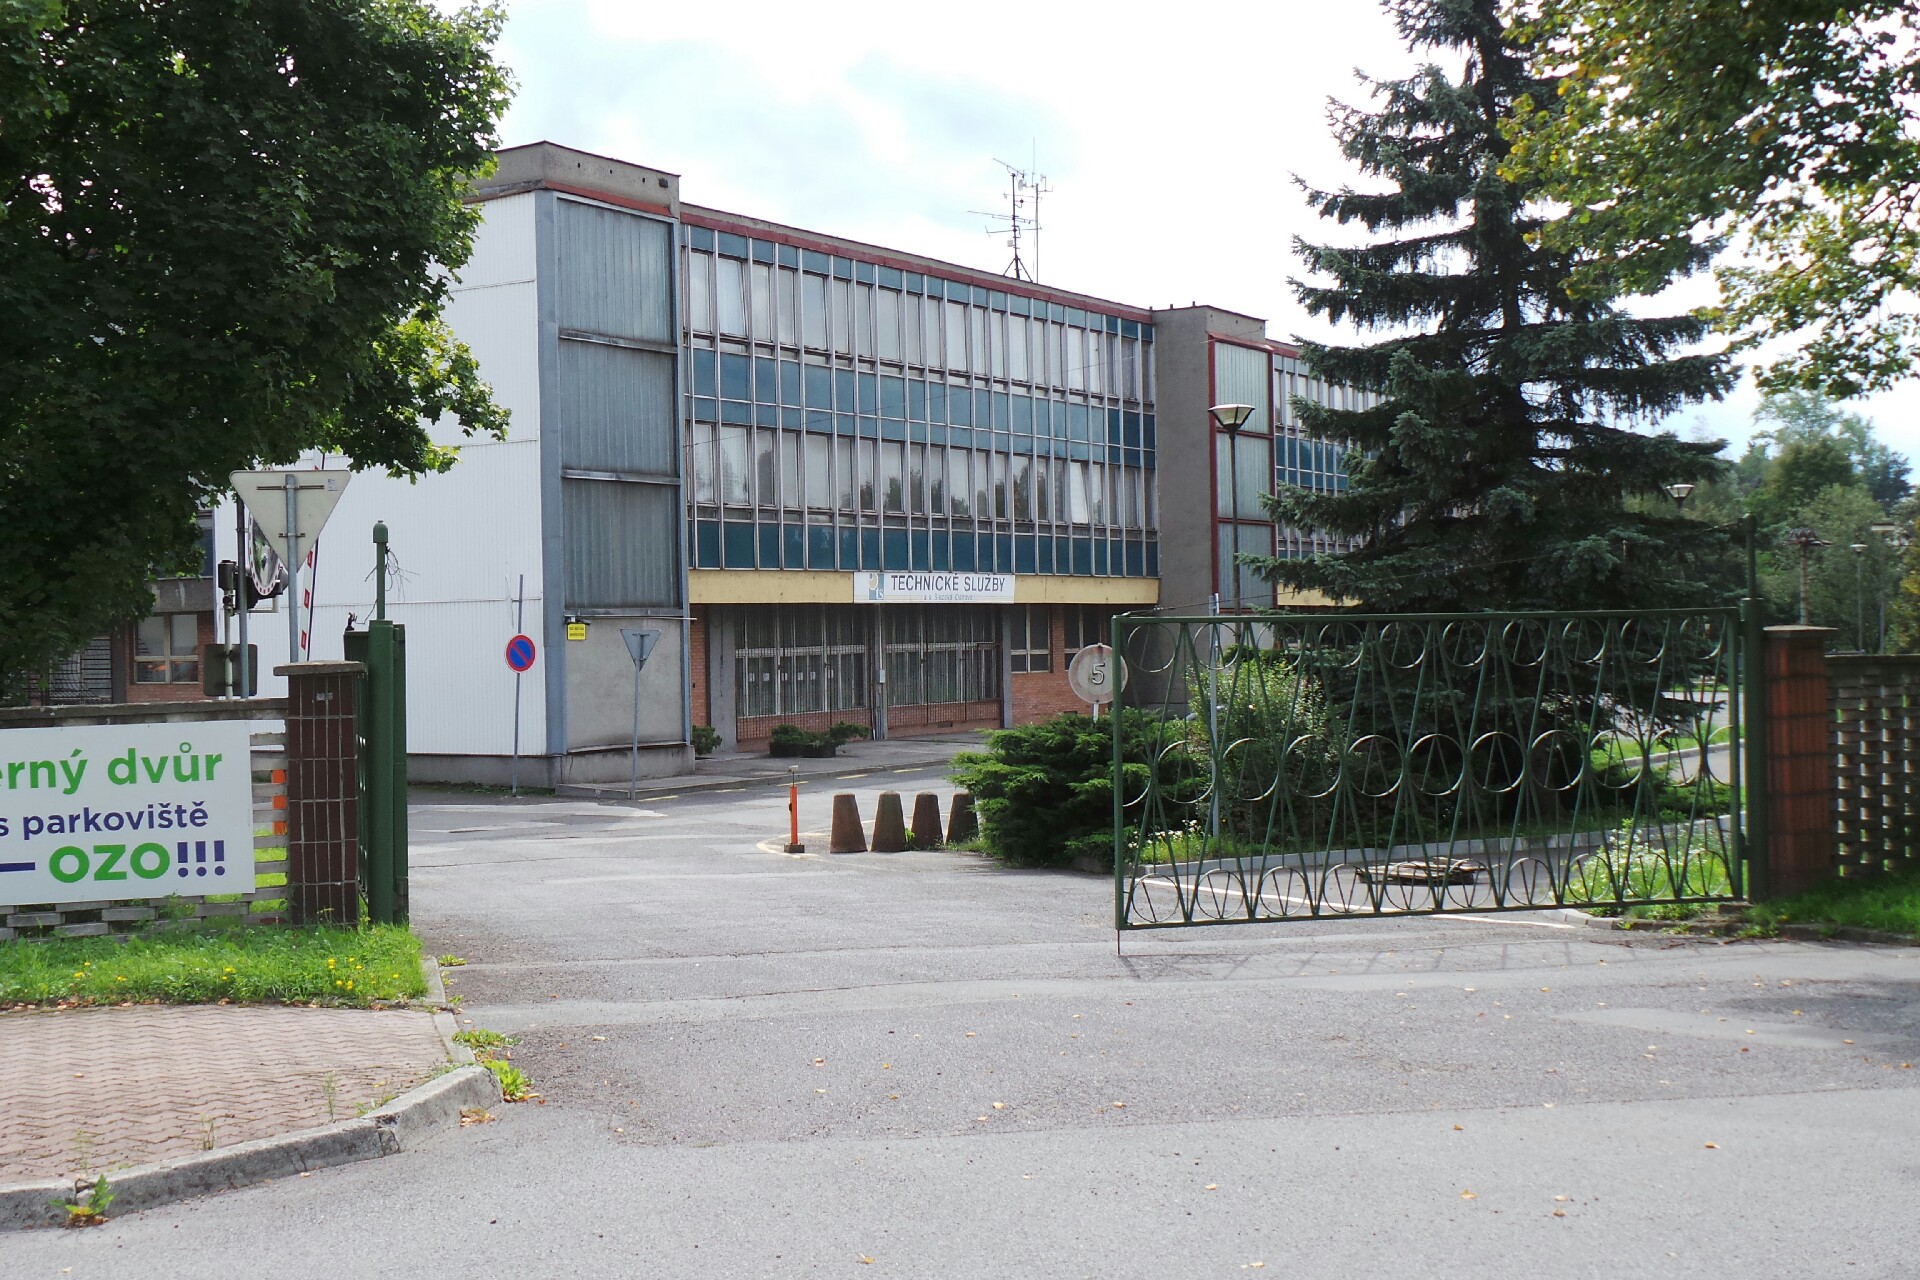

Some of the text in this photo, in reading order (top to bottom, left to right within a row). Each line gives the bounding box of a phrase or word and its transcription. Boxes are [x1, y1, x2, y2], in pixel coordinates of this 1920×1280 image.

[891, 573, 1006, 592] TECHNICKÉ SLUŽBY
[1091, 662, 1105, 685] 5
[0, 741, 223, 795] rný dvůr
[23, 800, 209, 841] parkoviště
[48, 840, 226, 884] OZO!!!
